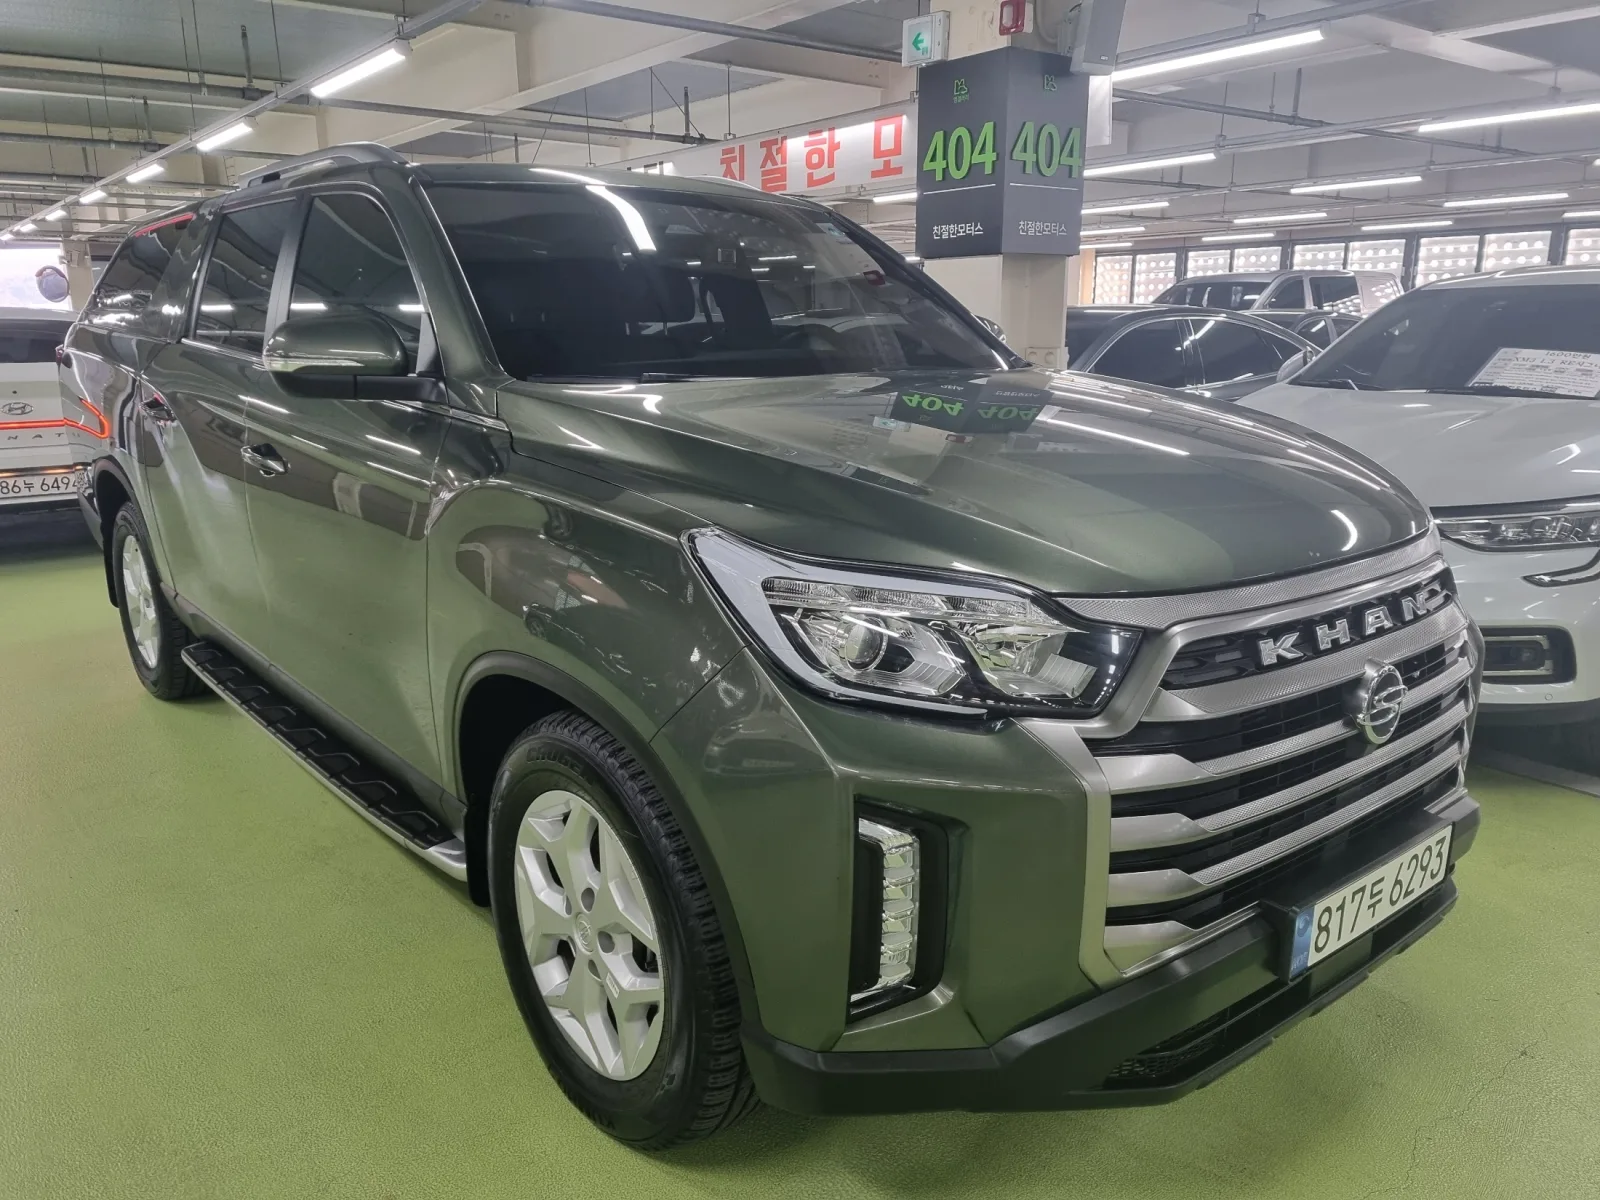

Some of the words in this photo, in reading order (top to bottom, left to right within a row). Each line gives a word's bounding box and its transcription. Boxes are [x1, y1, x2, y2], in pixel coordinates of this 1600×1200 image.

[923, 121, 997, 181] 404
[1012, 121, 1082, 179] 404
[932, 222, 984, 239] 친절한모터스
[1018, 220, 1067, 236] 친절한모터스
[1258, 590, 1428, 666] KHAN
[1314, 876, 1385, 953] 817두
[1389, 835, 1447, 907] 6293
